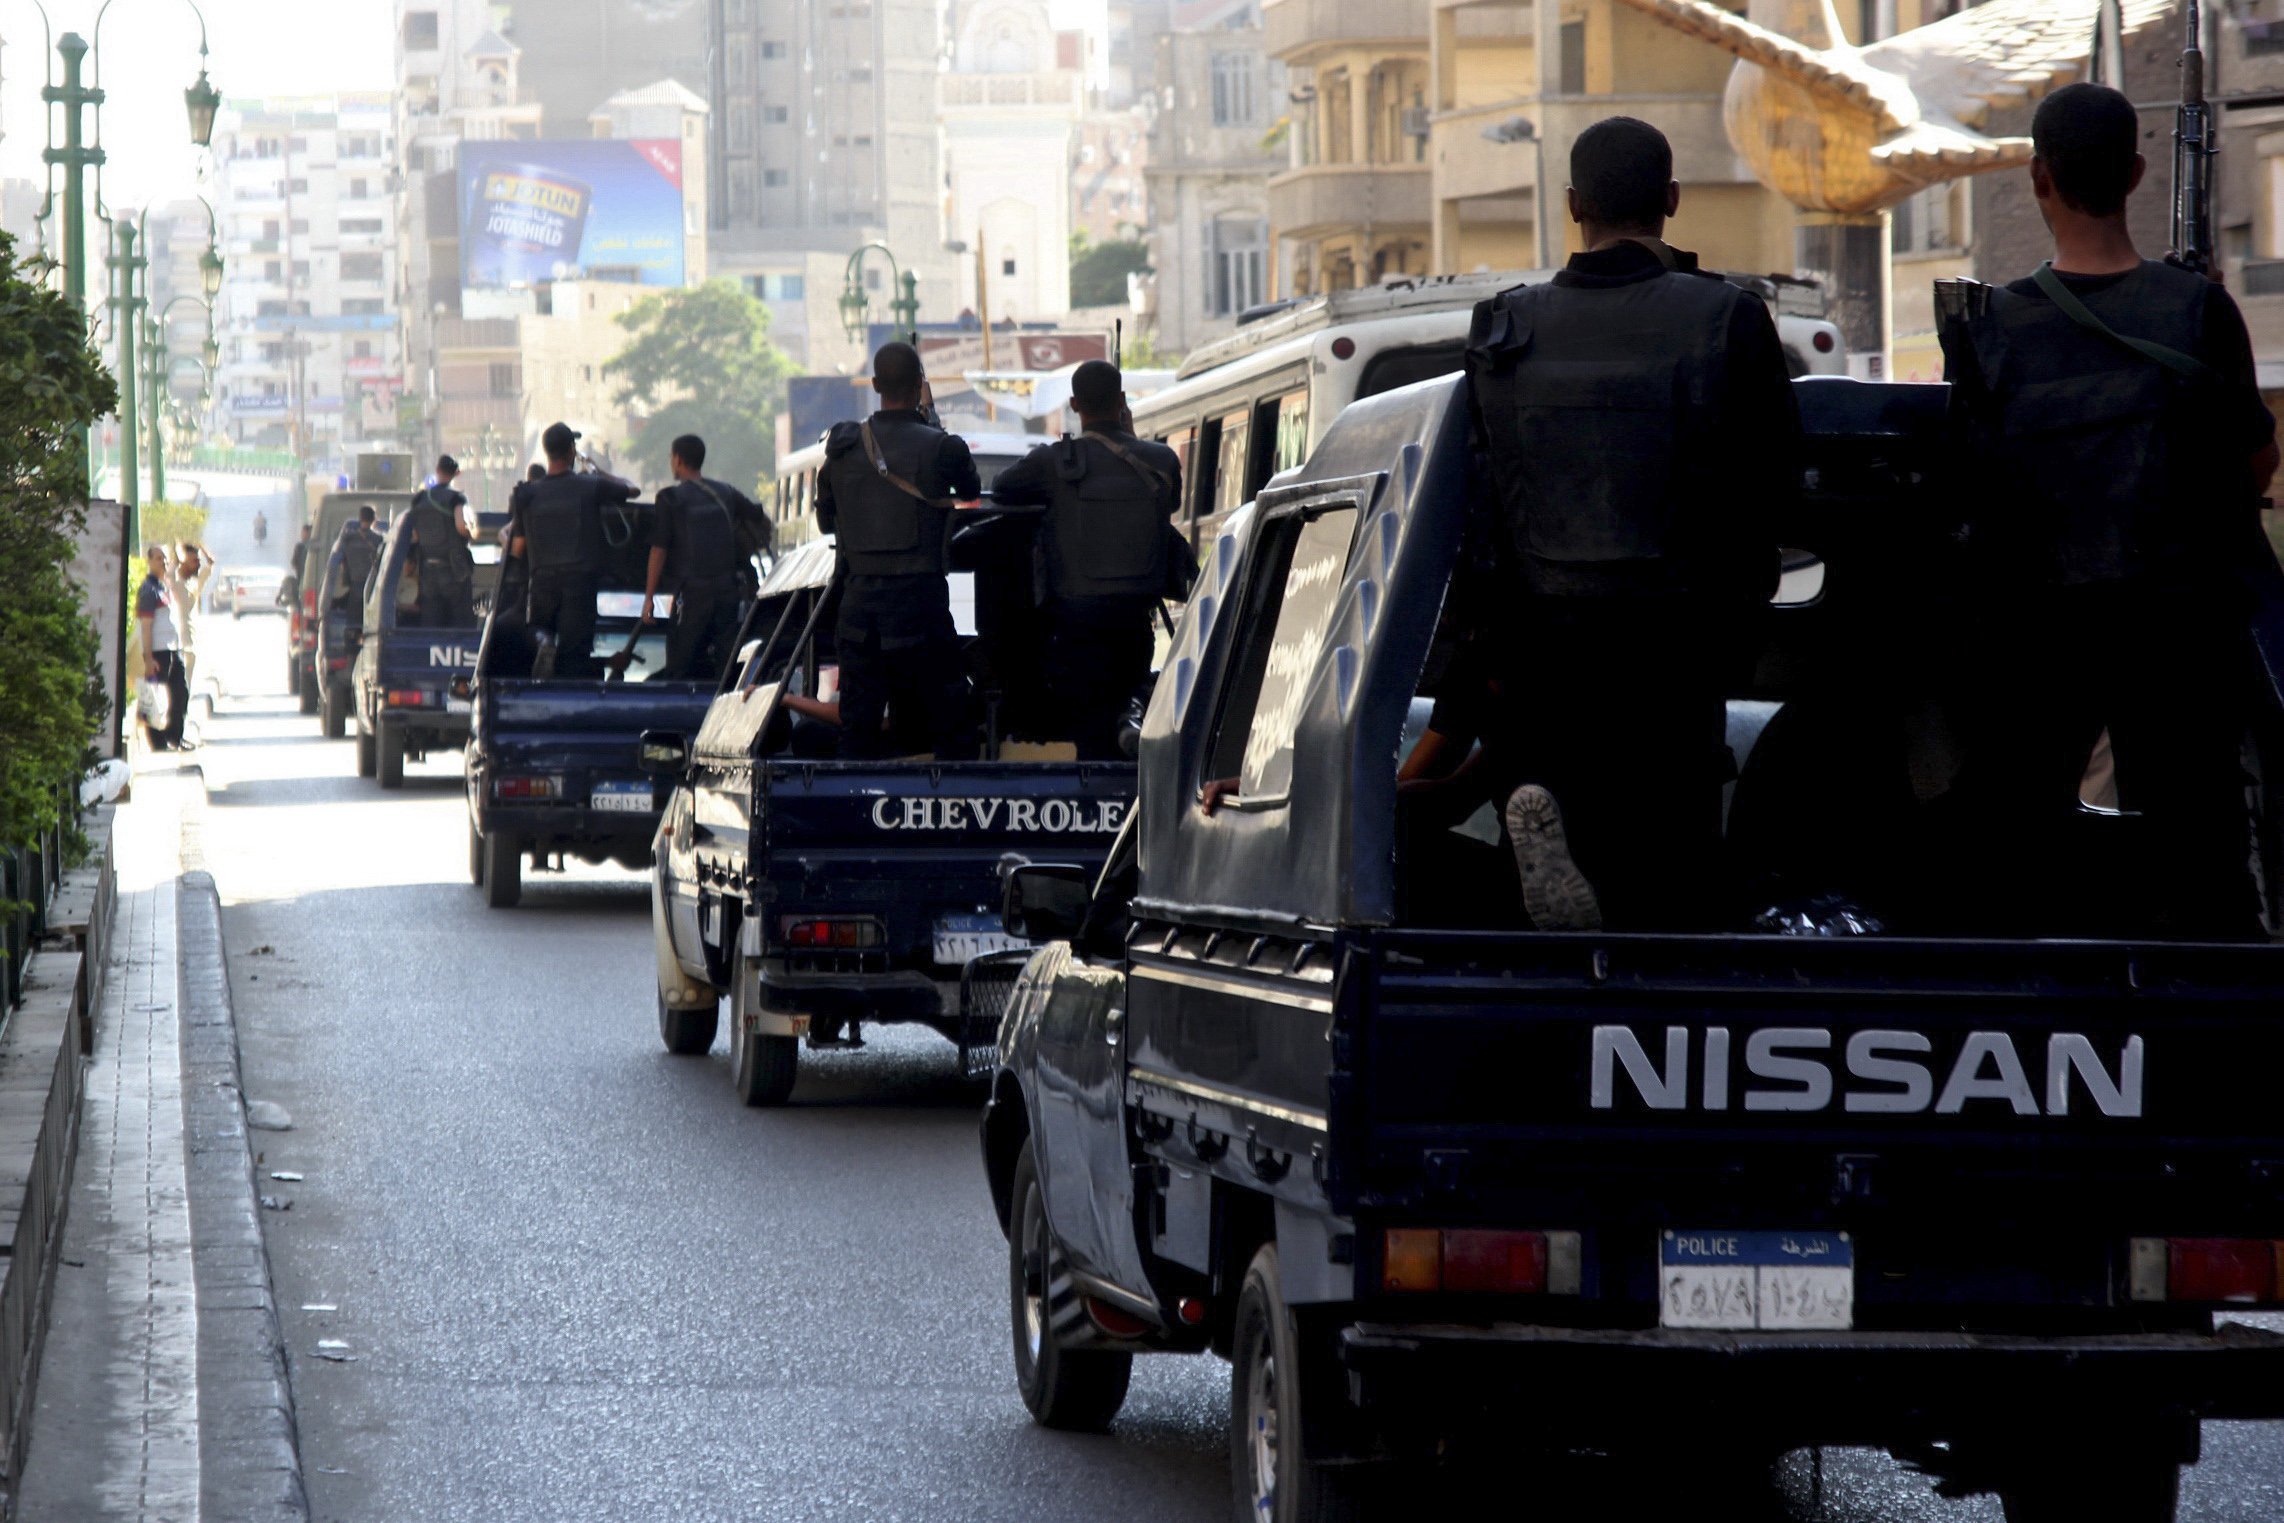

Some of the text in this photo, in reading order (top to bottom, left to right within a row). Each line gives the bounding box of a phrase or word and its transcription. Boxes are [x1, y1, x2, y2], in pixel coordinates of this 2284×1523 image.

[512, 182, 577, 212] JOTUN
[485, 216, 563, 247] JOTASHIELD
[872, 797, 1126, 833] CHEVROLE
[1591, 1025, 2143, 1117] NISSAN
[1677, 1237, 1739, 1256] POLICE
